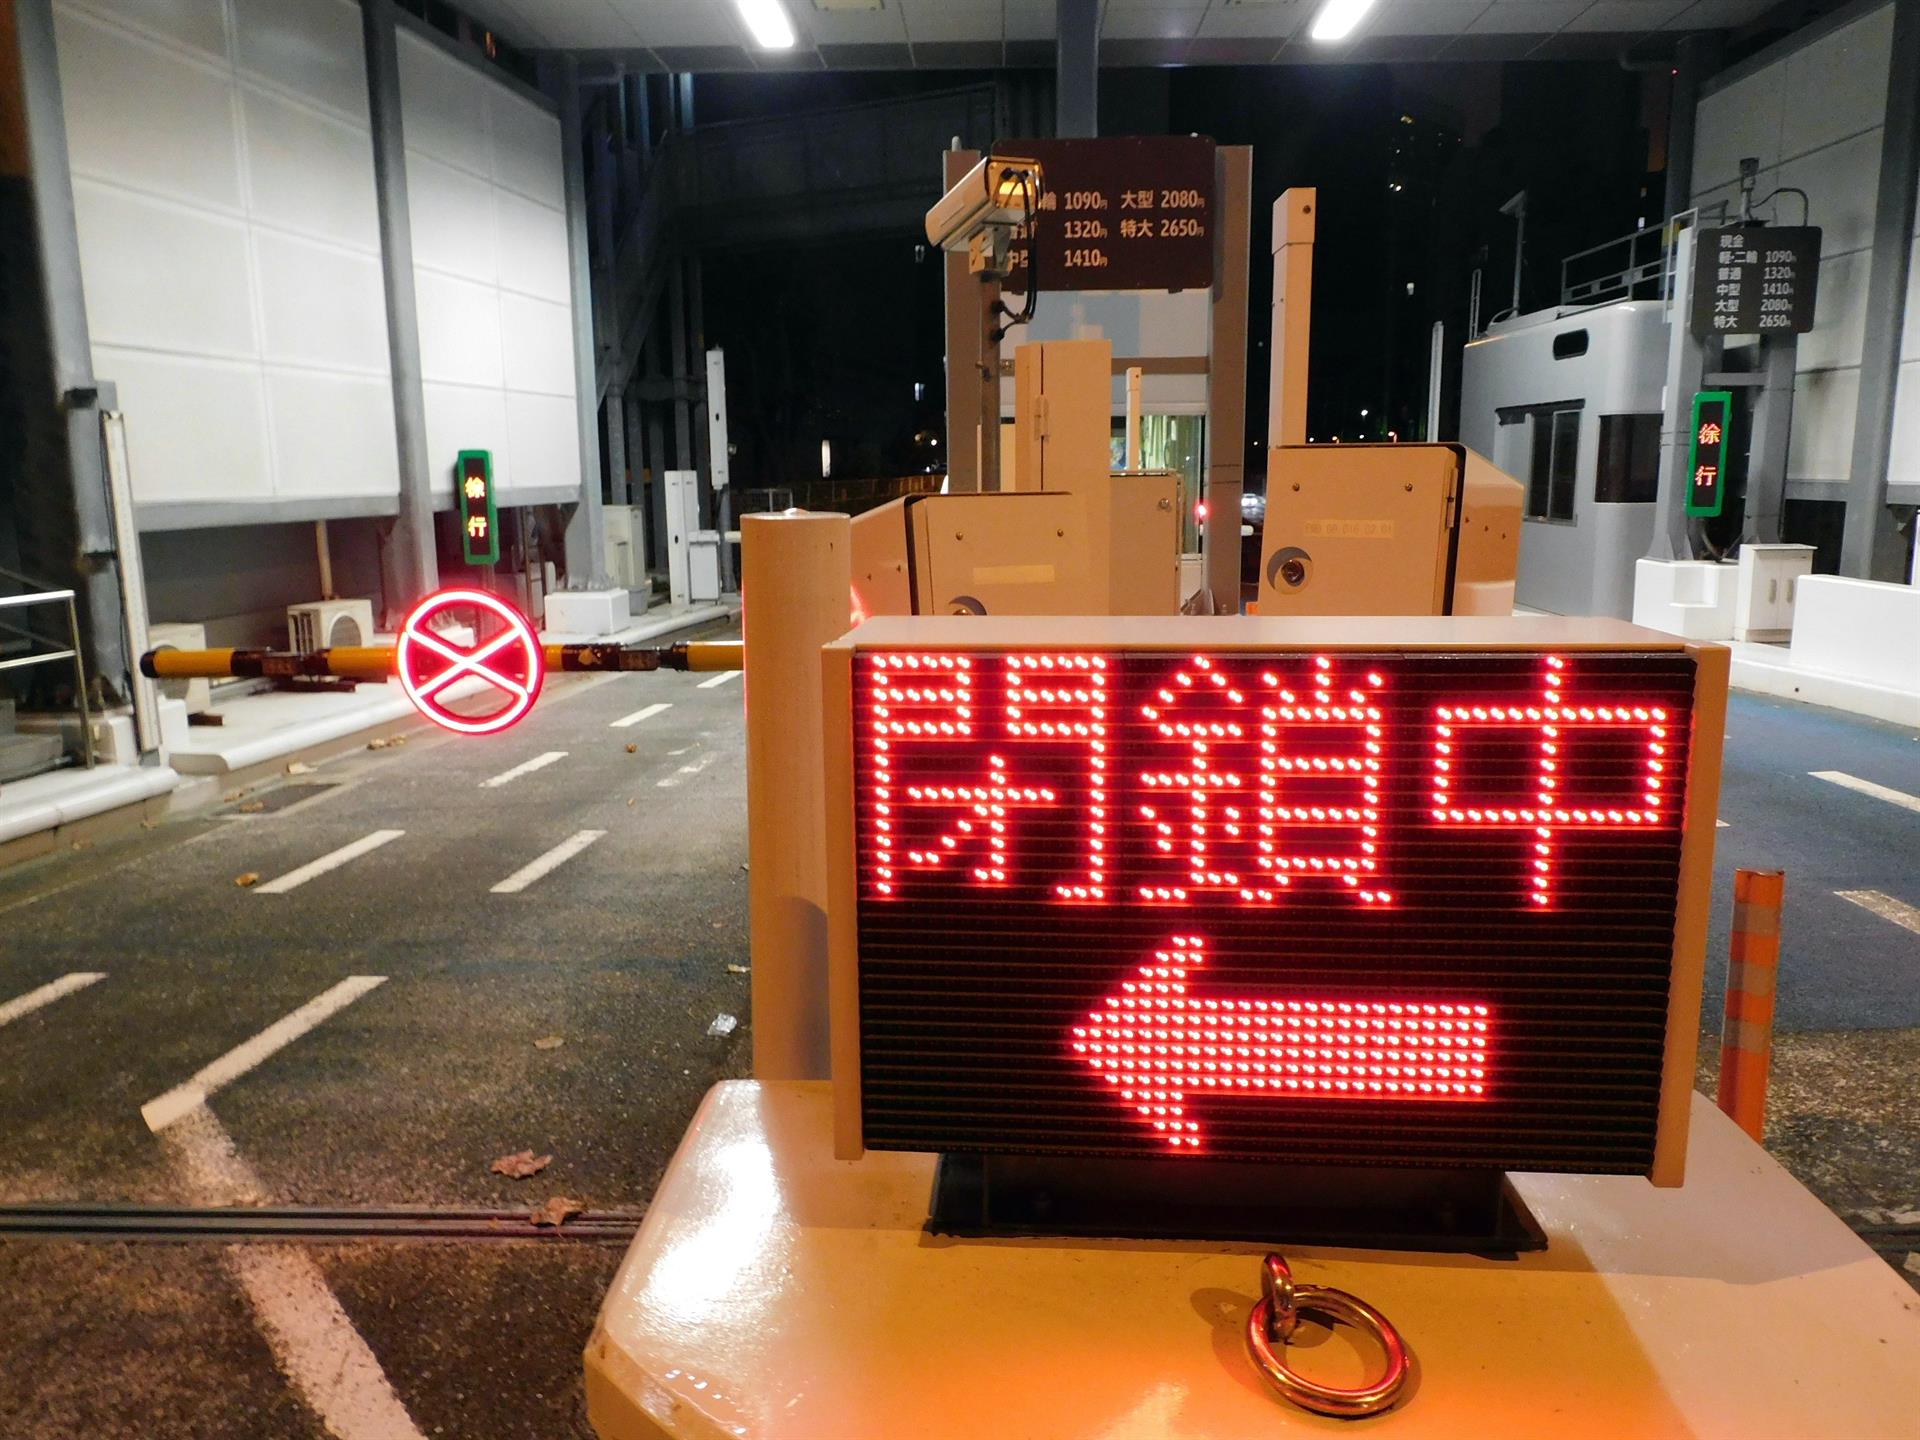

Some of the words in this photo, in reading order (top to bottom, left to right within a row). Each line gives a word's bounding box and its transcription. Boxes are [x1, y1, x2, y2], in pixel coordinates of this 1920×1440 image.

[1121, 190, 1154, 209] 大型
[1120, 219, 1153, 238] 特大
[1720, 234, 1744, 248] 現金
[1717, 267, 1742, 280] 普通
[1716, 283, 1741, 296] 中型
[1714, 299, 1739, 312] 大型
[1713, 315, 1739, 328] 特大
[1695, 423, 1721, 486] 徐行
[870, 653, 1669, 908] 閉鎖中
